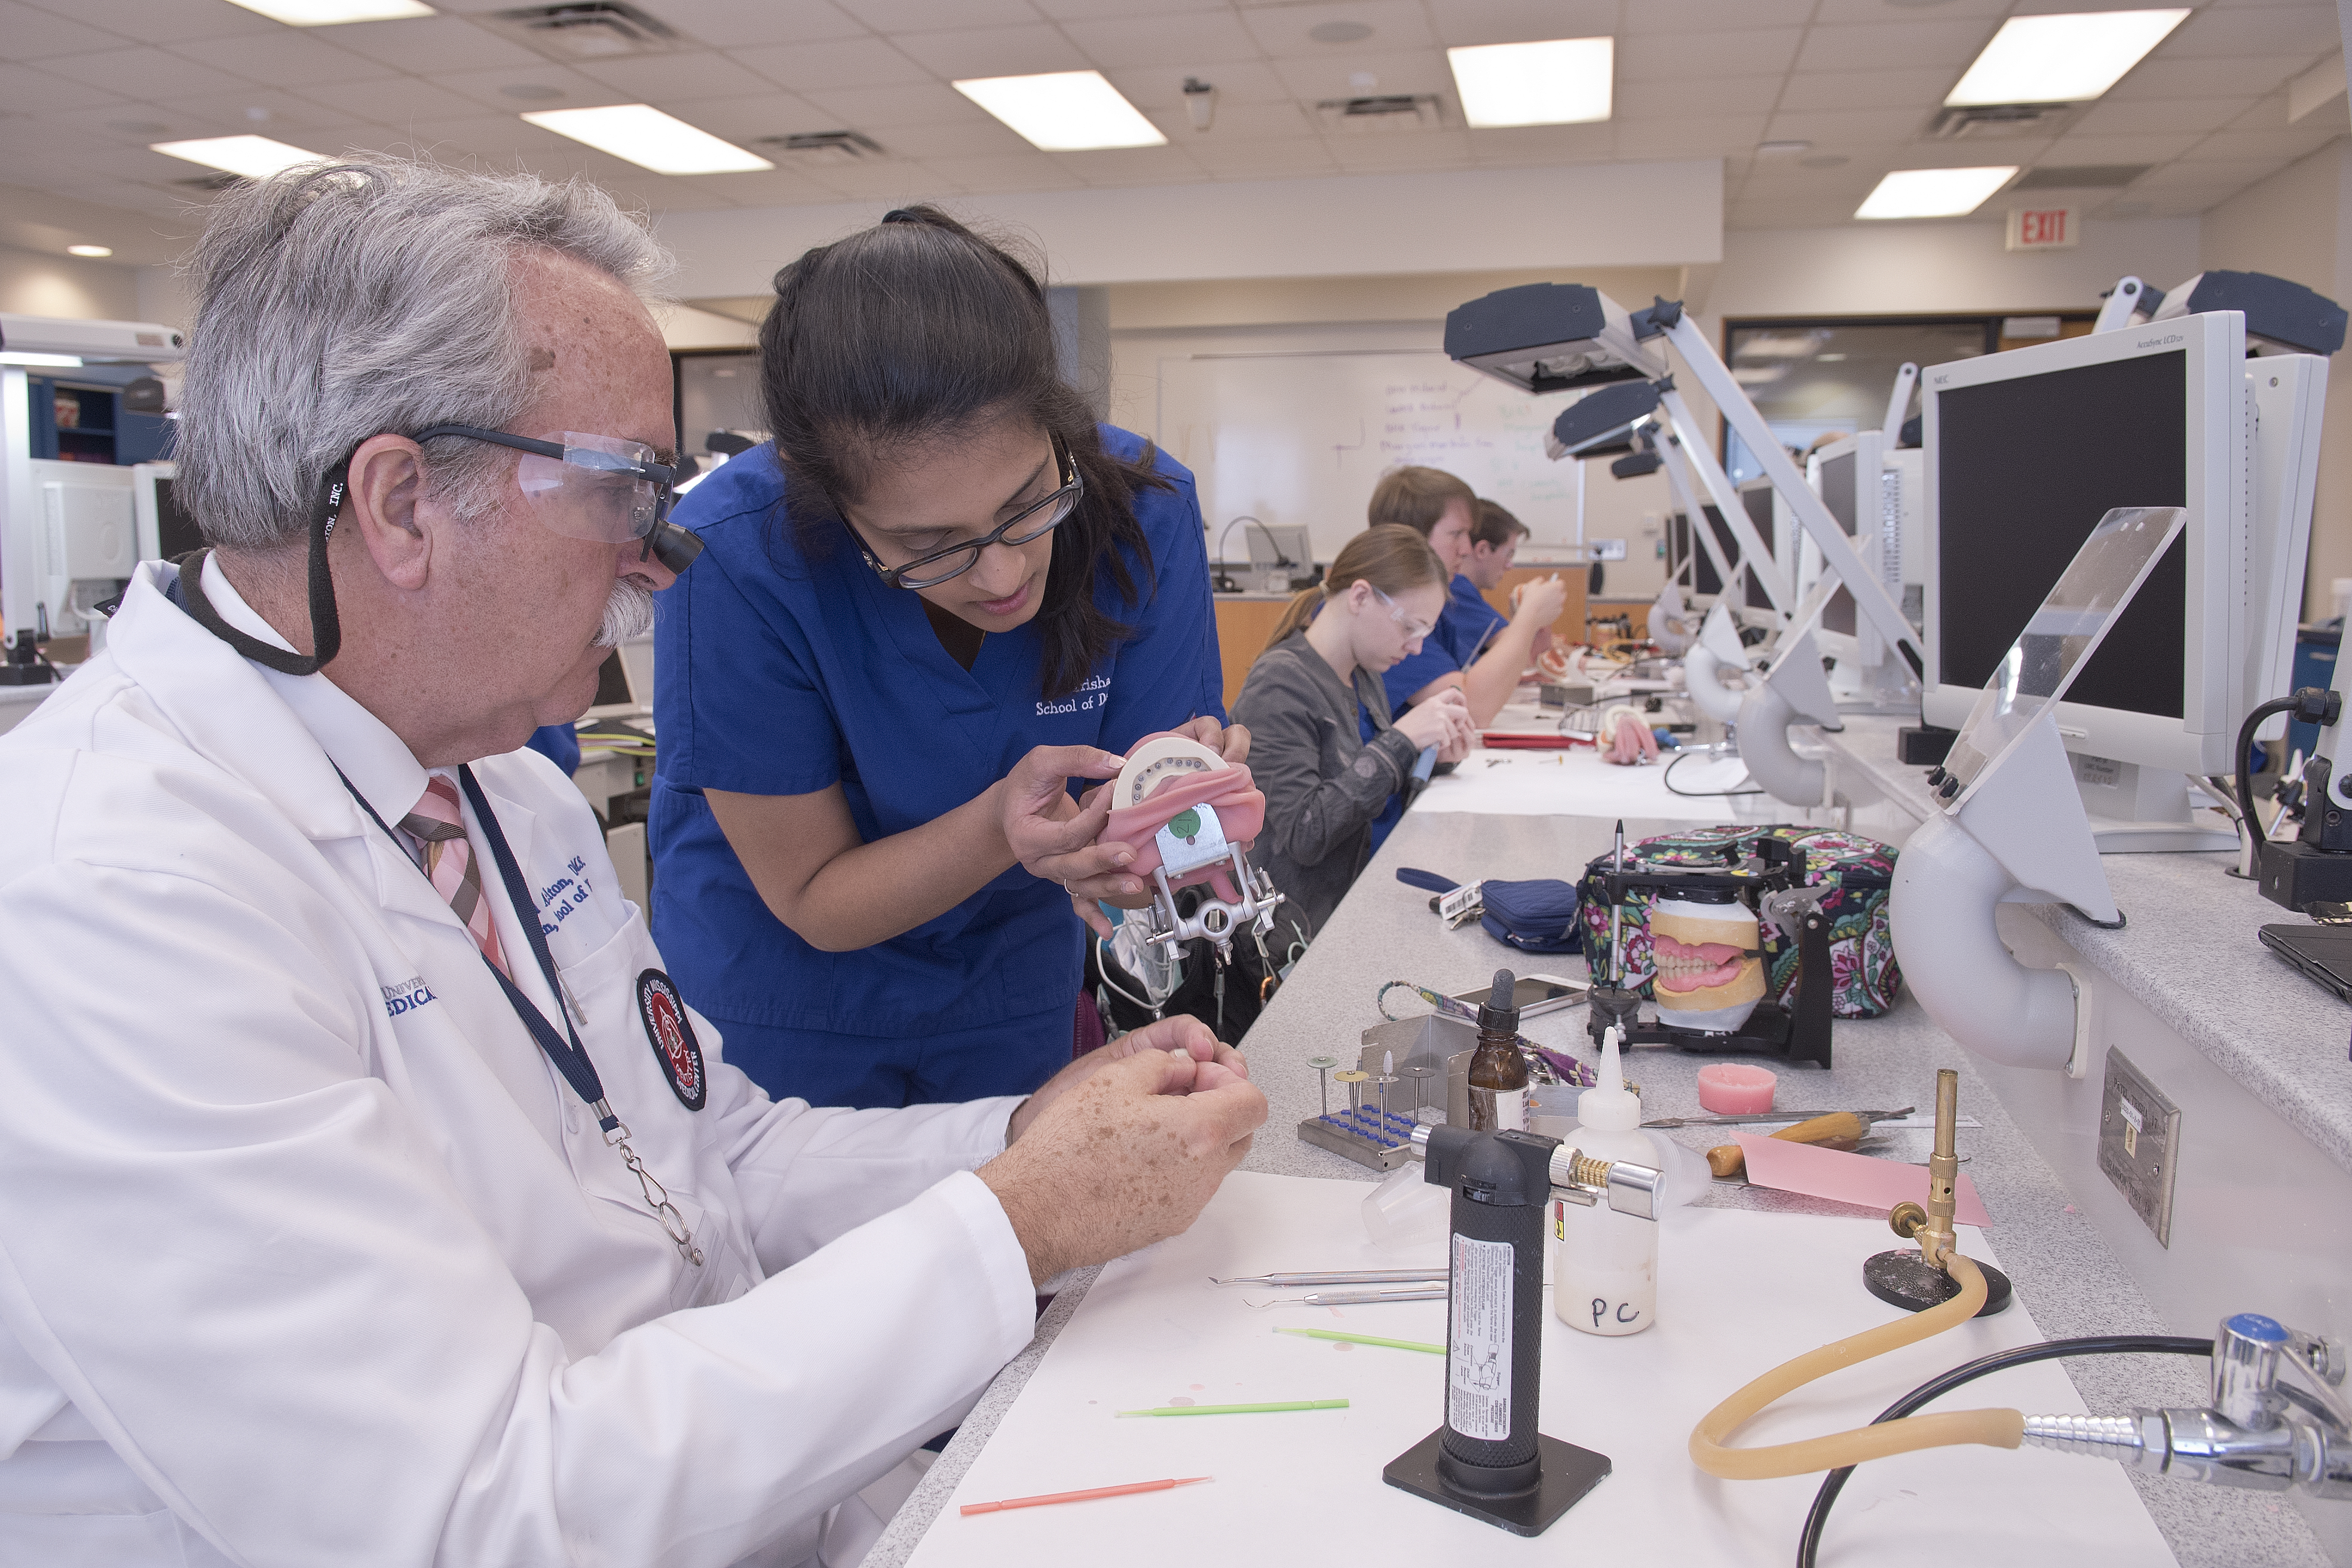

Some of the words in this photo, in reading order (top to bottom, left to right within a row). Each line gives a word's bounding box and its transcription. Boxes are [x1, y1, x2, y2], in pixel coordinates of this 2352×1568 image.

[2022, 210, 2067, 244] EXIT
[329, 483, 344, 507] INC.
[325, 514, 337, 543] ION,
[1075, 675, 1111, 693] risha
[1036, 699, 1077, 716] School
[1082, 696, 1094, 710] of
[573, 885, 589, 903] of
[650, 979, 682, 1024] MISSISSIPPI
[644, 984, 664, 1050] UNIVERSITY
[2152, 1115, 2158, 1129] 17
[2145, 1202, 2151, 1217] 18
